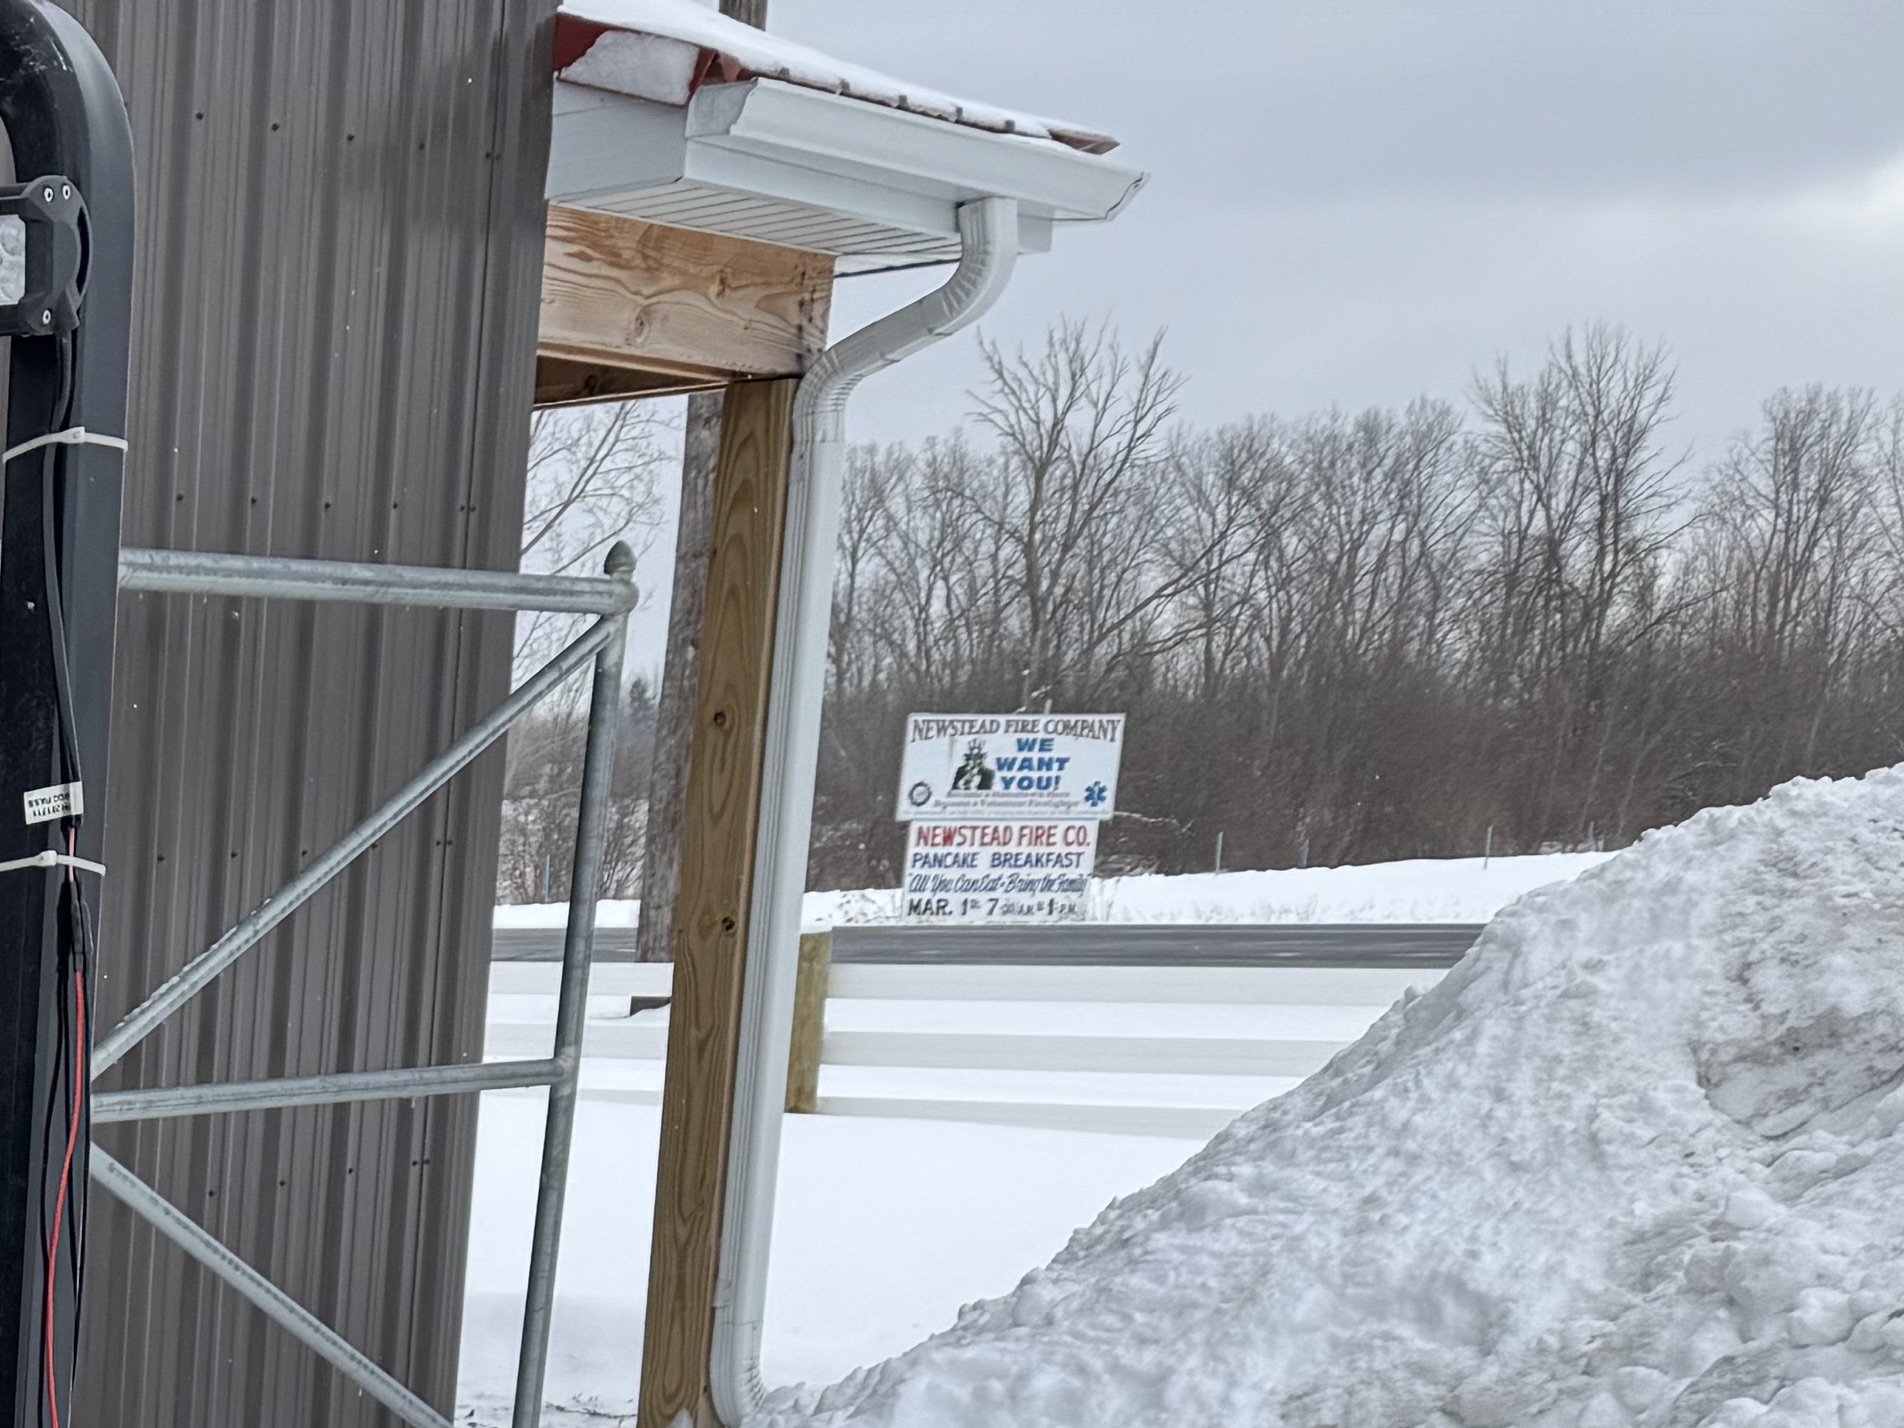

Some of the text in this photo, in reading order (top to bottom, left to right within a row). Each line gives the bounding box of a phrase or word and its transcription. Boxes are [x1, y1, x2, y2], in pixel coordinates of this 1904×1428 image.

[911, 719, 1121, 743] NEWSTEAD FIRE COMPANY
[1016, 738, 1054, 752] WE
[996, 757, 1070, 771] WANT
[1000, 776, 1061, 792] YOU!
[916, 825, 1091, 848] NEWSTEAD FIRE CO.
[911, 852, 1085, 869] PANCAKE BREAKFAST
[908, 898, 953, 915] MAR.
